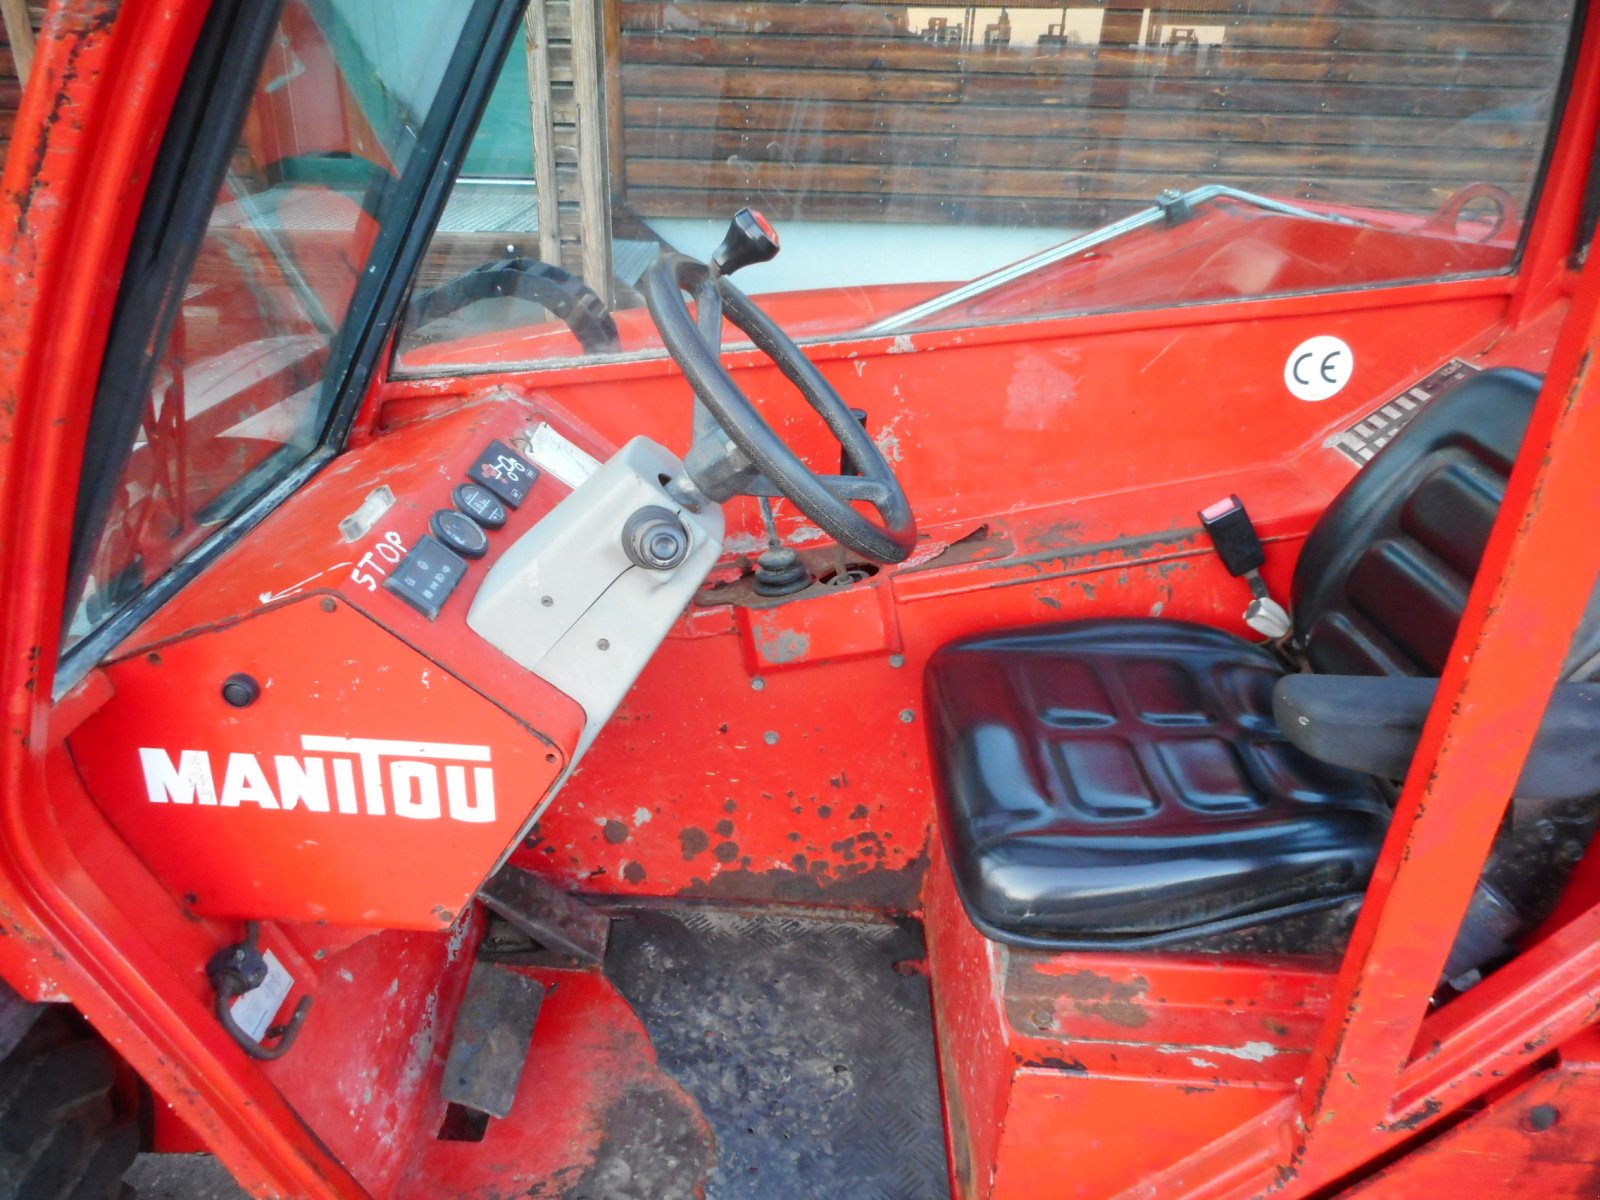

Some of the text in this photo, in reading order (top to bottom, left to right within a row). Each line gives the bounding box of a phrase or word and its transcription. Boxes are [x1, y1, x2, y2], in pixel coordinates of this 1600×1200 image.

[1293, 351, 1341, 385] CE
[351, 531, 408, 592] STOP
[139, 735, 496, 823] MANITOU
